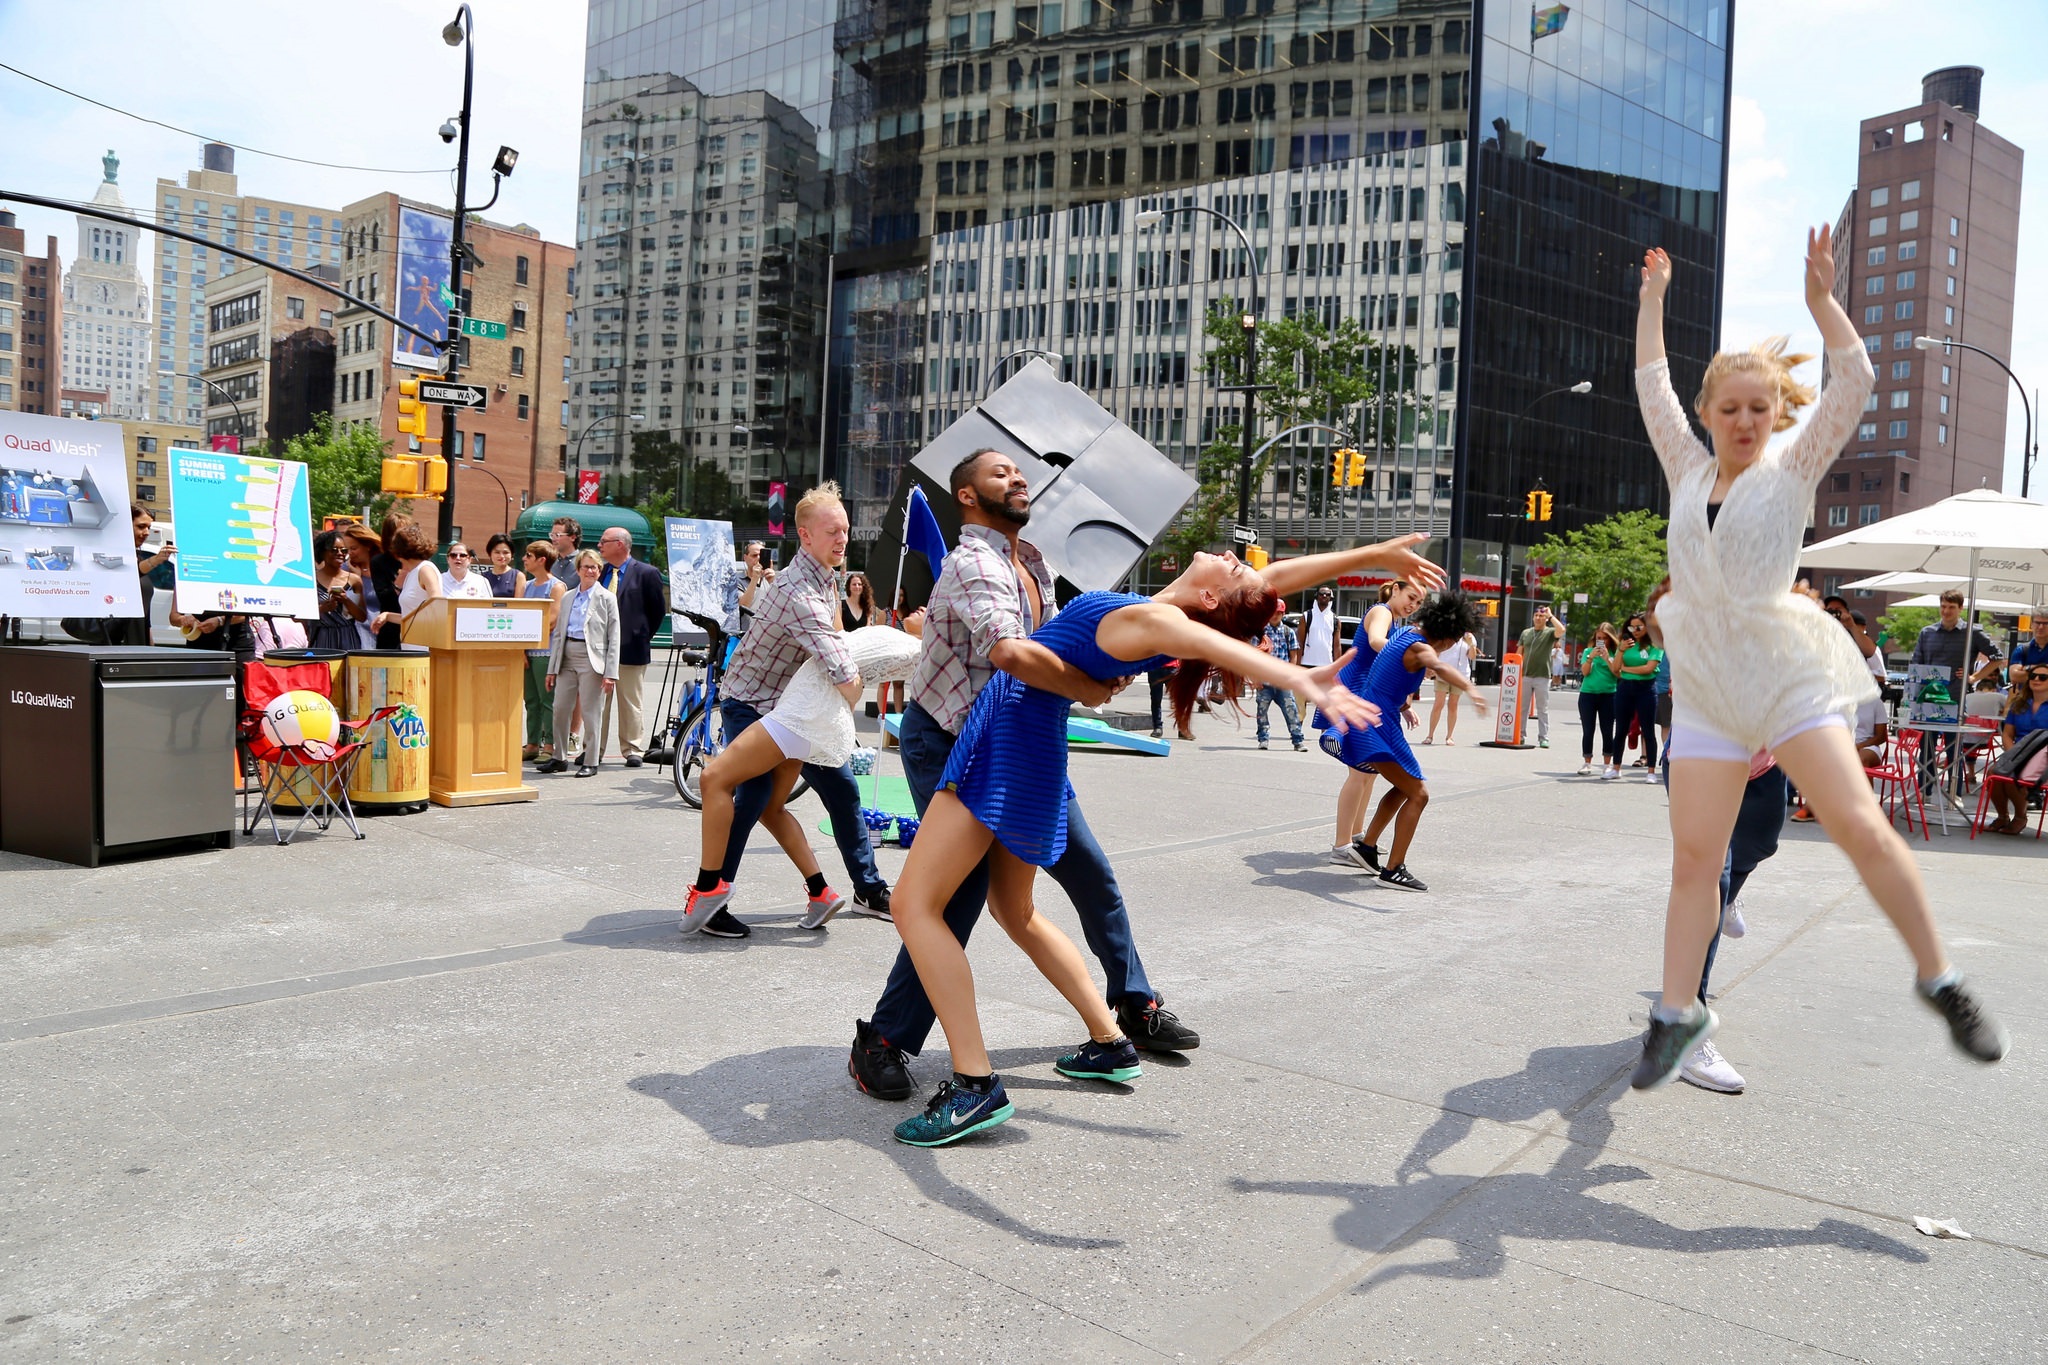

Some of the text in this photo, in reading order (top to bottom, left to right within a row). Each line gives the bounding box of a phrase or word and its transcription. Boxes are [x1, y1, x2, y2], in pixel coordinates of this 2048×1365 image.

[470, 321, 498, 335] E 8 St
[429, 388, 476, 400] ONE WAY
[179, 459, 225, 471] SUMMER
[179, 467, 226, 480] STREETS
[670, 523, 696, 532] SUMMIT
[671, 531, 700, 540] EVEREST
[24, 587, 90, 595] LGQuadWash.com
[243, 597, 266, 605] NYC
[487, 618, 513, 630] DOT
[1506, 666, 1516, 674] NO
[11, 690, 73, 709] LG QuadWash
[389, 717, 425, 737] VITA
